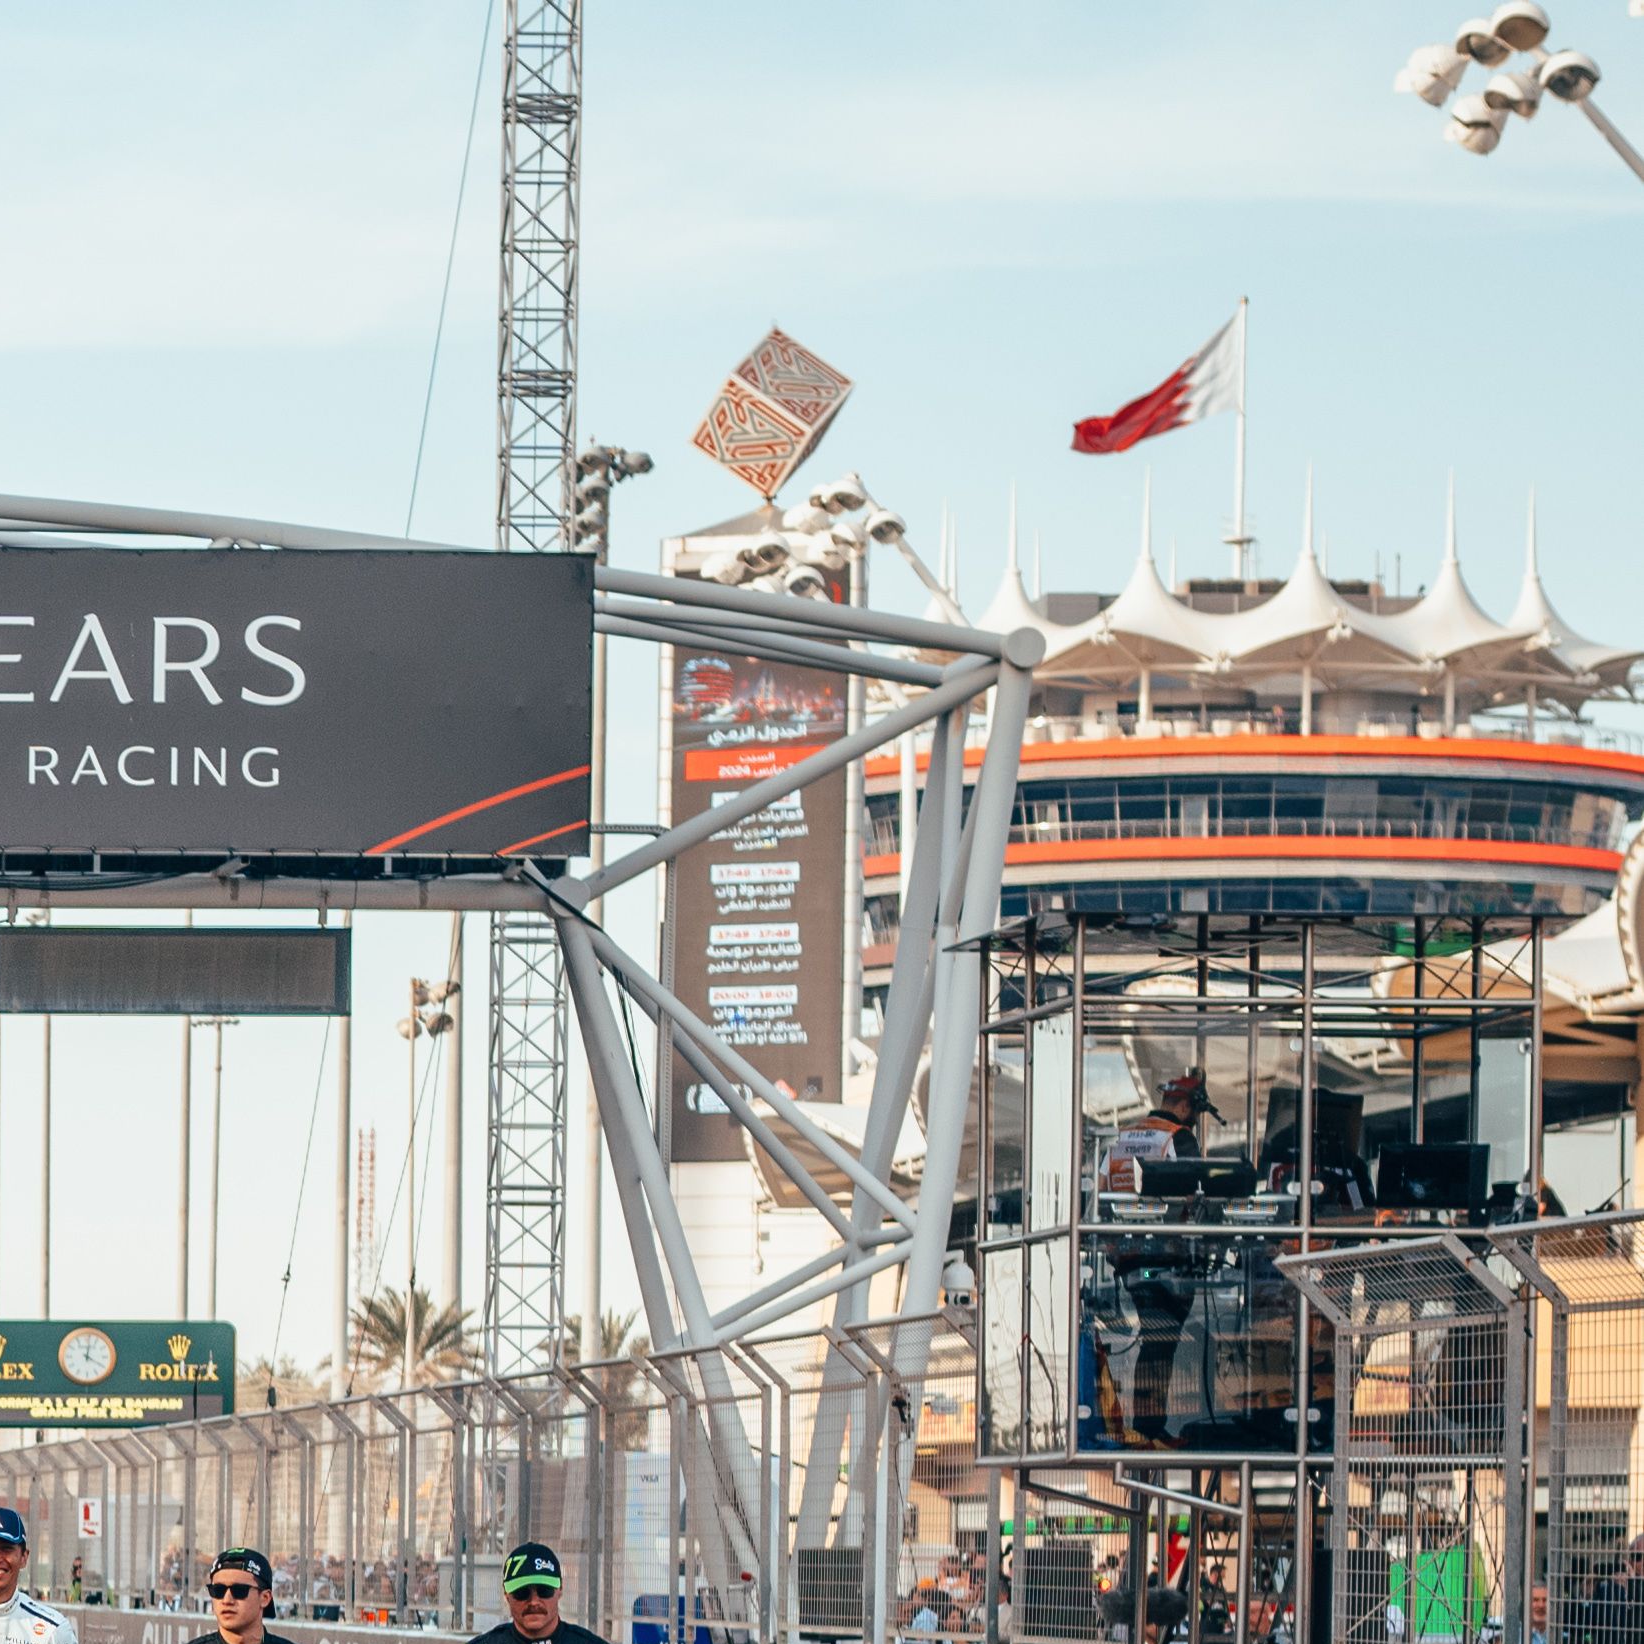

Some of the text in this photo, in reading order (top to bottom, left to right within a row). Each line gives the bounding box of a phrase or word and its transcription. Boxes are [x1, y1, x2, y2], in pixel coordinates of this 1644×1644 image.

[707, 723, 807, 747] الجدول الزمني
[28, 745, 280, 788] RACING
[718, 765, 750, 778] 2024
[139, 1364, 219, 1381] ROLEX
[66, 1397, 99, 1409] GULF
[101, 1397, 123, 1409] AIR
[125, 1398, 183, 1410] BAHRAIN
[78, 1408, 108, 1418] PRIX
[504, 1555, 528, 1579] 17
